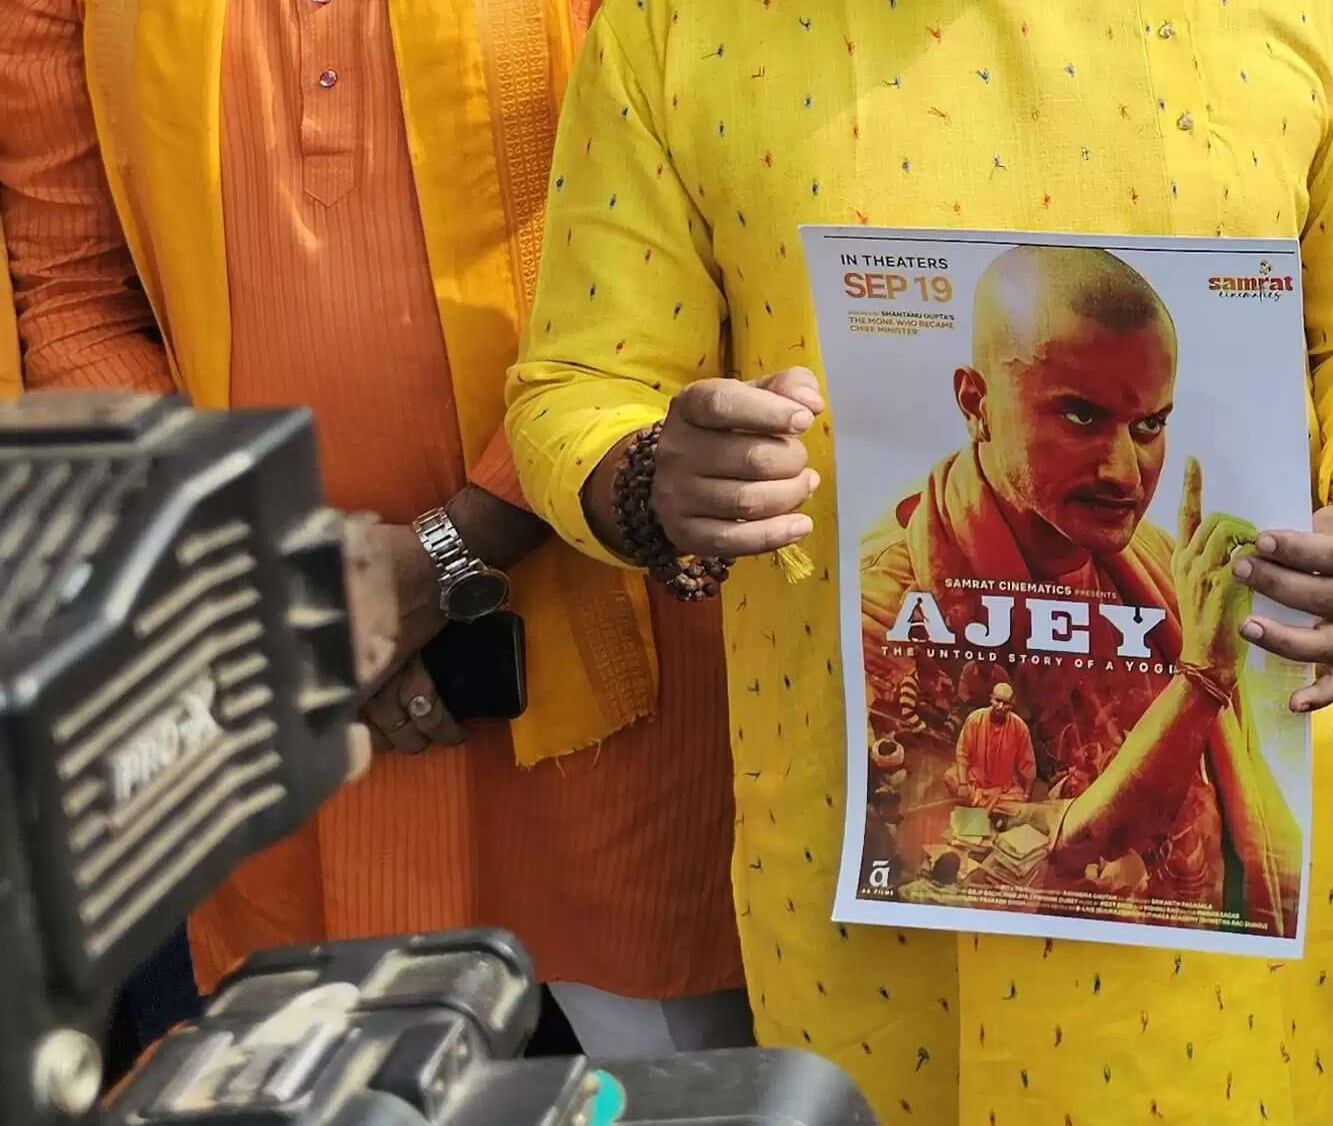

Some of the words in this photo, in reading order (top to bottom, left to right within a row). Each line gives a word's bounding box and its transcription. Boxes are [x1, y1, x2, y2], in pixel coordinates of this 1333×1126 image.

[840, 254, 858, 266] IN
[862, 255, 949, 270] THEATERS
[843, 272, 908, 300] SEP
[913, 275, 953, 303] 19
[1208, 275, 1294, 291] samrat
[945, 578, 995, 591] SAMRAT
[999, 580, 1072, 596] CINEMATICS
[1075, 588, 1118, 600] PRESENTS
[886, 591, 1166, 659] AJEY
[881, 645, 914, 657] THE
[927, 648, 997, 662] UNTOLD
[1008, 653, 1064, 667] STORY
[1074, 658, 1094, 670] OF
[1105, 661, 1114, 671] A
